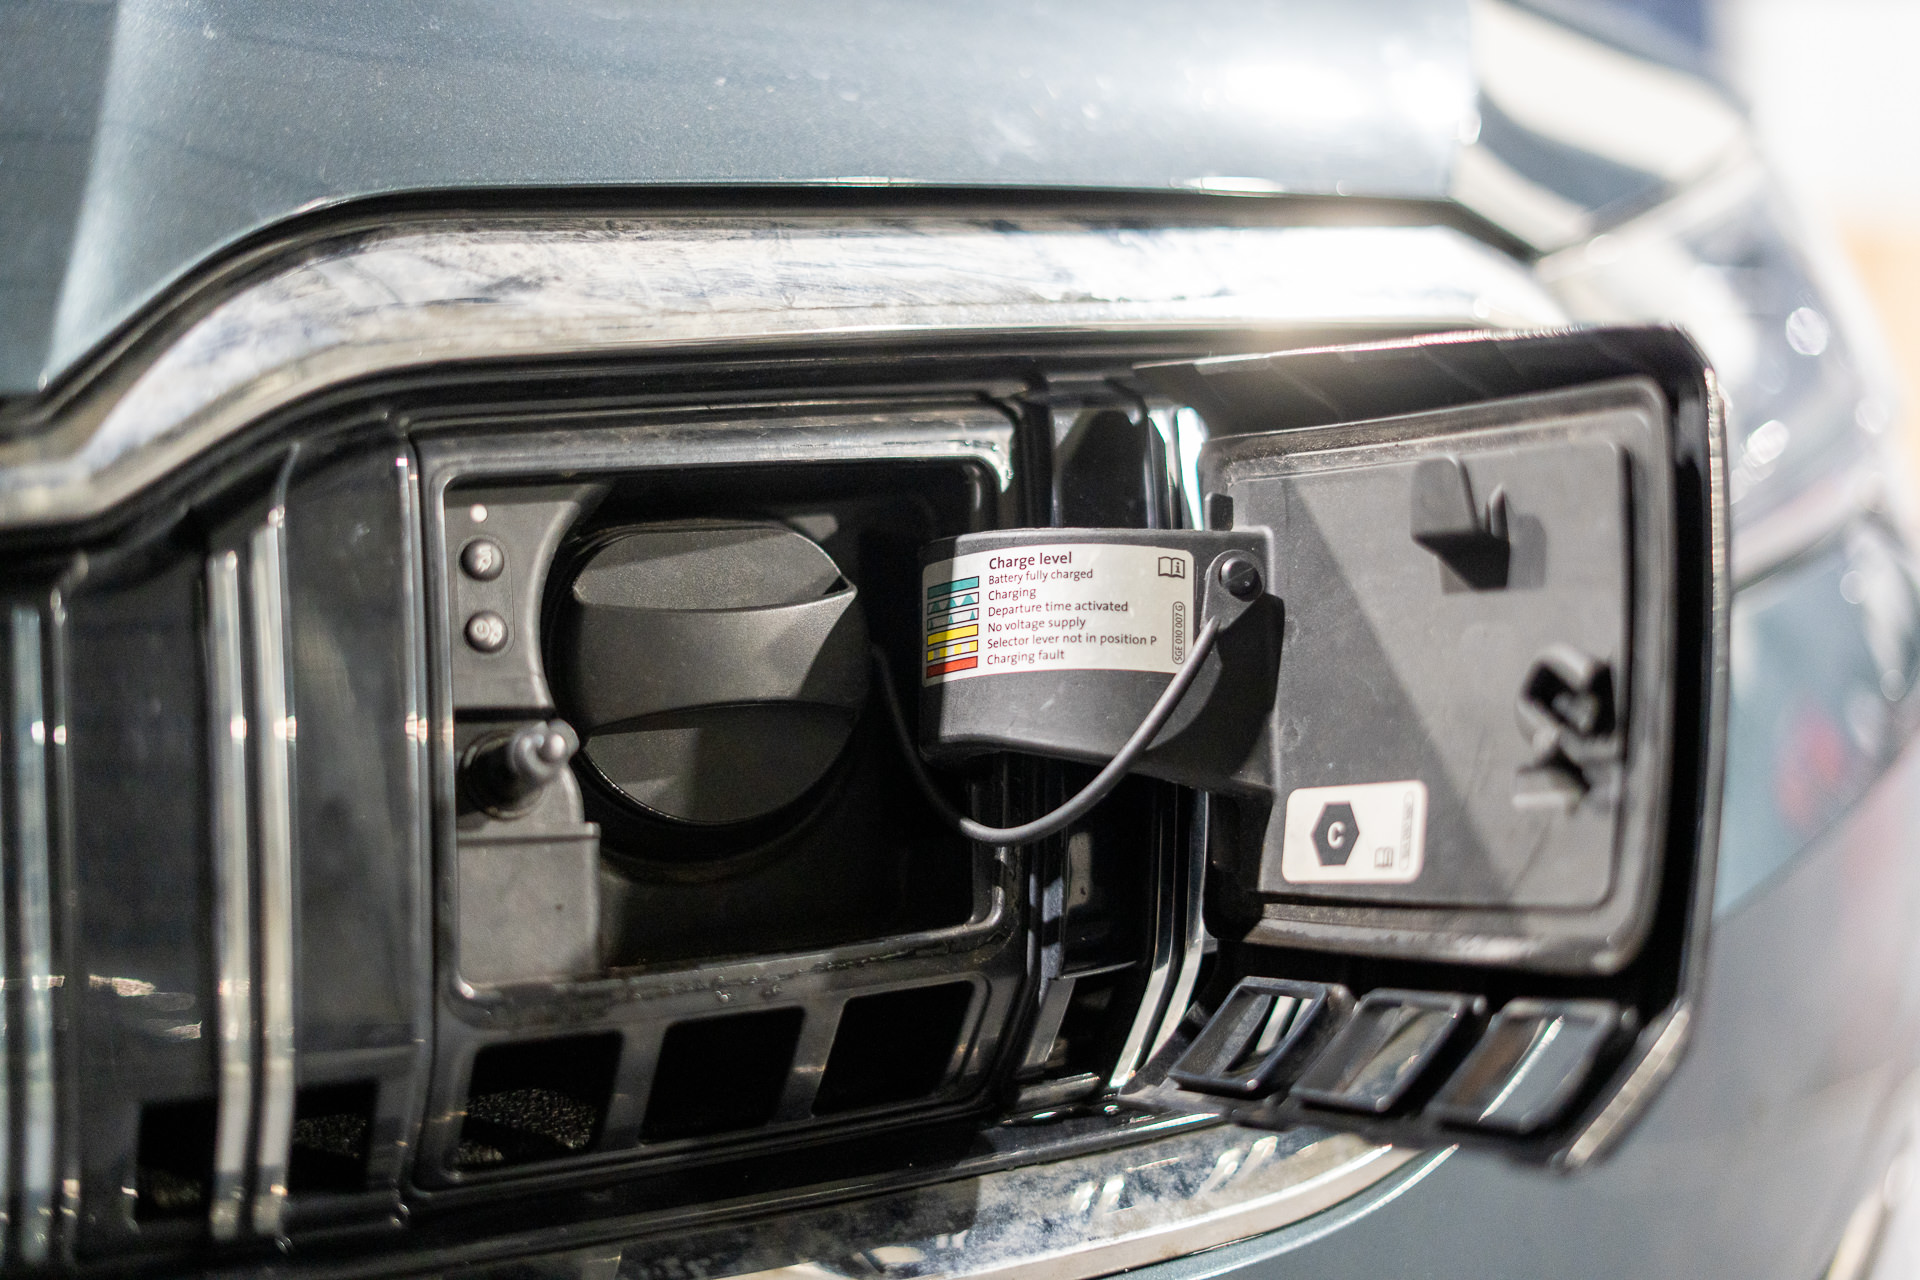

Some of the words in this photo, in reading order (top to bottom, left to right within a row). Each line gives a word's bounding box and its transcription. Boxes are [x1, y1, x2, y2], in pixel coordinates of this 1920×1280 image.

[989, 556, 1035, 570] Charge
[1040, 551, 1072, 564] level
[989, 573, 1023, 584] Battery
[1026, 570, 1048, 582] fully
[1050, 568, 1093, 582] charged
[988, 588, 1036, 601] Charging
[988, 604, 1042, 618] Departure
[1045, 602, 1072, 612] time
[1075, 600, 1128, 612] activated
[988, 622, 1002, 632] No
[1005, 620, 1044, 632] voltage
[1048, 616, 1086, 630] supply
[1174, 612, 1183, 628] 007
[988, 636, 1029, 649] Selector
[1032, 634, 1060, 644] lever
[1063, 633, 1082, 643] not
[1086, 633, 1096, 643] in
[1100, 634, 1146, 646] position
[1150, 636, 1157, 645] P
[1174, 630, 1183, 644] 010
[987, 652, 1034, 666] Charging
[1038, 650, 1064, 660] fault
[1327, 821, 1346, 849] C
